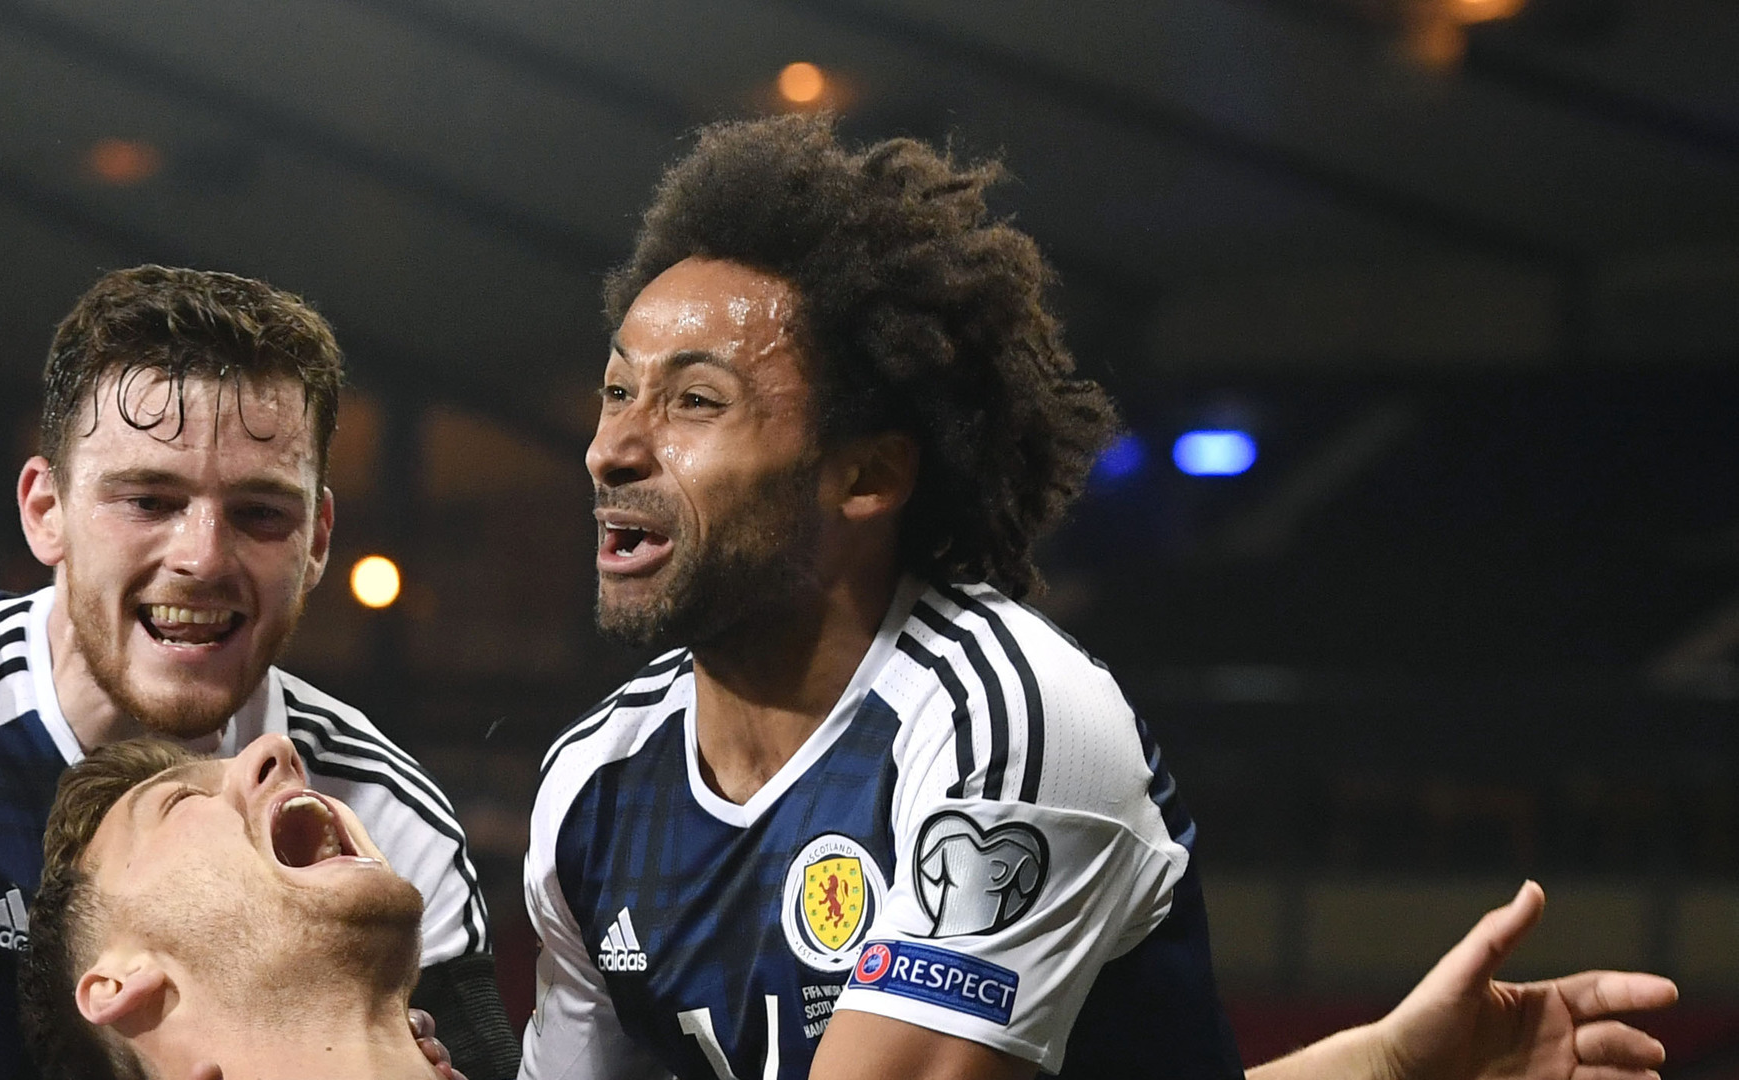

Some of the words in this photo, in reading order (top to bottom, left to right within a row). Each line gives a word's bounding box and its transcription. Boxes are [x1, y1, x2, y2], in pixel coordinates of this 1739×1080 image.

[808, 842, 853, 860] SCOTLAND
[598, 950, 648, 972] adidas
[891, 955, 1016, 1009] RESPECT
[802, 985, 824, 1001] FIFA
